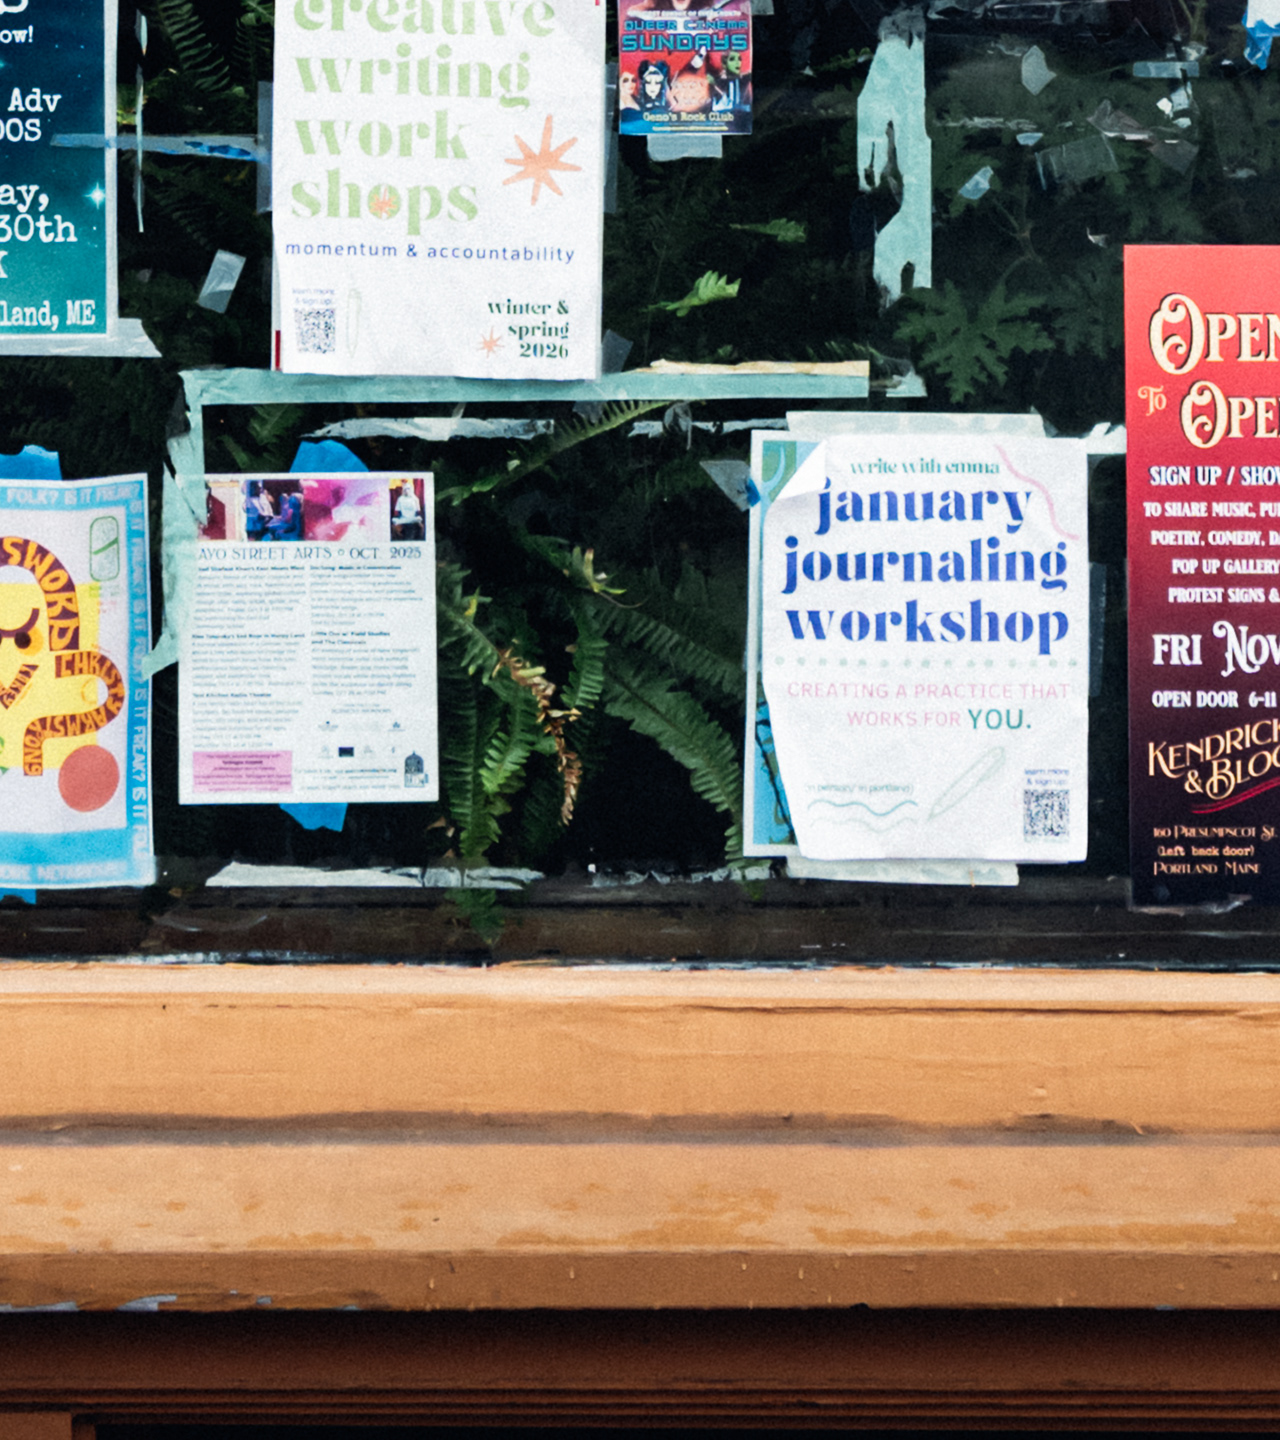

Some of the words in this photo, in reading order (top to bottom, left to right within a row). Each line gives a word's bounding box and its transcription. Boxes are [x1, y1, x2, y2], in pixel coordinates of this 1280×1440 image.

[622, 32, 746, 50] SUNDAYS
[295, 43, 530, 109] writing
[8, 88, 61, 112] Adv
[295, 110, 467, 159] work
[292, 168, 478, 236] shops
[286, 243, 397, 256] momentum
[407, 244, 417, 257] &
[428, 247, 574, 264] accountability
[66, 300, 95, 325] ME
[488, 299, 551, 314] winter
[557, 301, 568, 314] &
[508, 321, 569, 340] spring
[520, 343, 568, 358] 2026
[815, 477, 1031, 535] january
[233, 547, 286, 559] STREET
[294, 547, 332, 558] ARTS
[350, 548, 378, 559] OCT
[390, 547, 421, 558] 2025
[782, 536, 1067, 594] journaling
[2, 537, 80, 651] SWORD
[786, 600, 1068, 655] workshop
[1152, 634, 1202, 665] FRI
[968, 709, 1031, 729] YOU.
[1185, 770, 1203, 793] &
